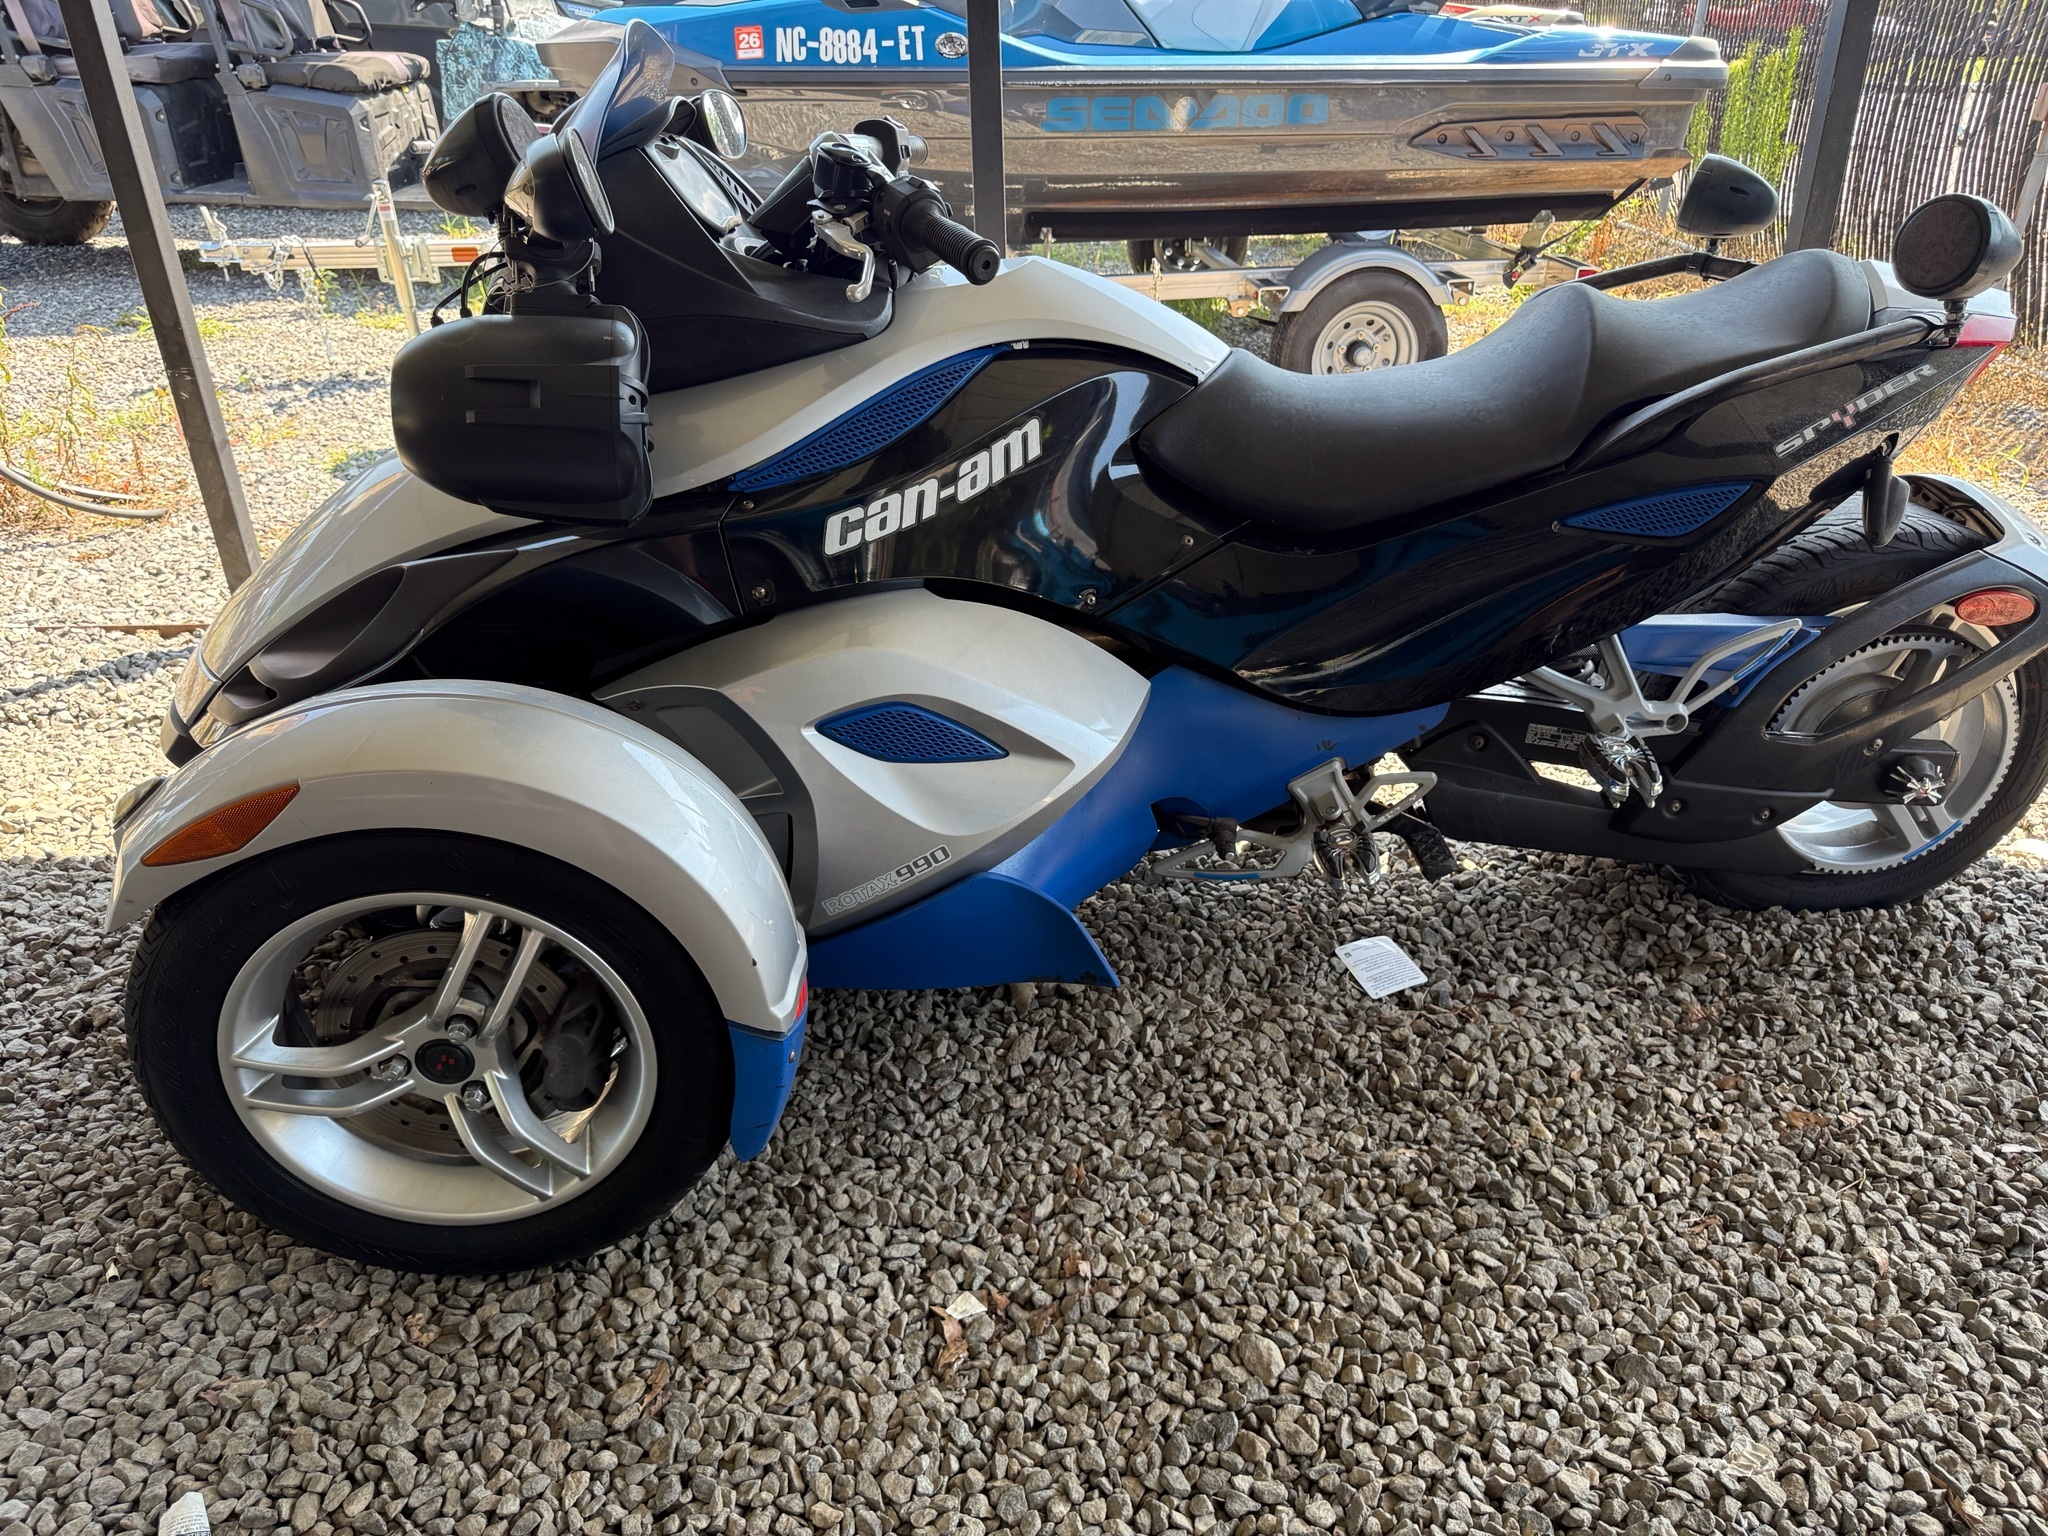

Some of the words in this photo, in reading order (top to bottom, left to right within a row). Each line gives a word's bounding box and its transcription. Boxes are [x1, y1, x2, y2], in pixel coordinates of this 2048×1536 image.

[738, 33, 760, 49] 26
[776, 25, 925, 64] NC-8884-ET
[1774, 363, 1938, 459] SPYDER
[823, 416, 1042, 556] can-am
[822, 871, 899, 915] ROTAX
[895, 845, 951, 884] 990
